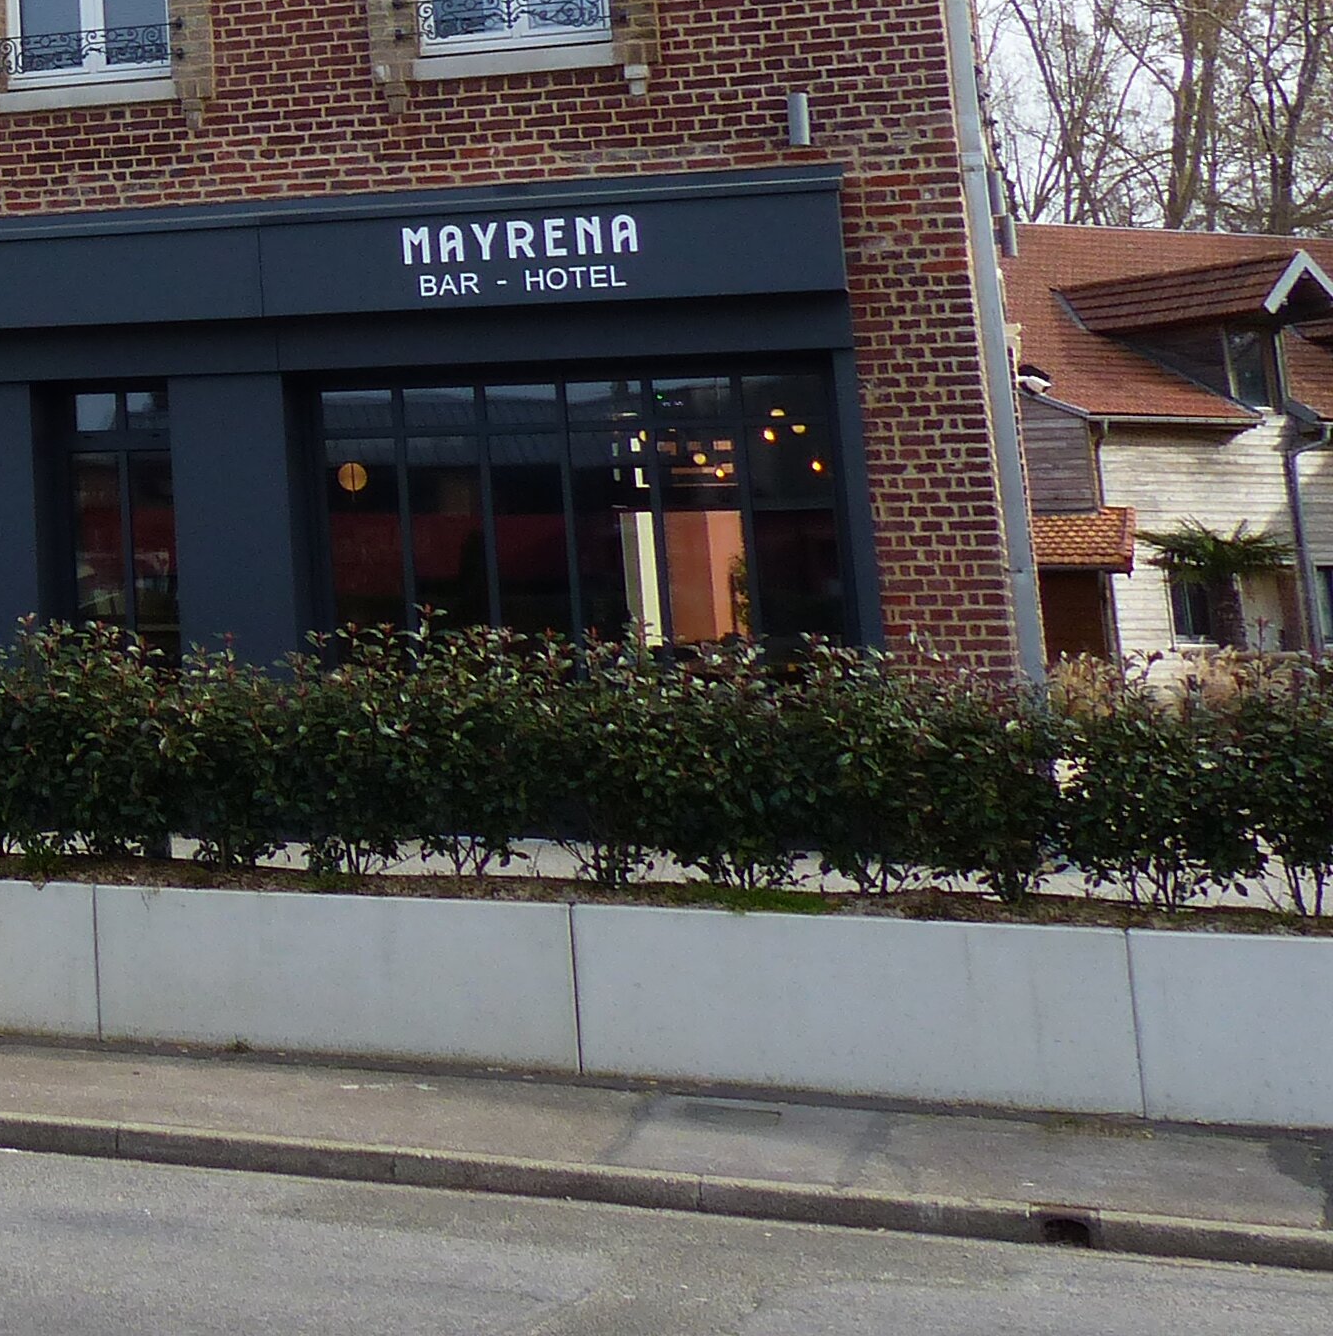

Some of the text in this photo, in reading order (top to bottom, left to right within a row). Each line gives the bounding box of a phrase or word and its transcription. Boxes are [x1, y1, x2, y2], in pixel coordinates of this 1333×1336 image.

[401, 214, 639, 265] MAYRENA
[419, 272, 480, 297] BAR
[524, 265, 628, 292] HOTEL
